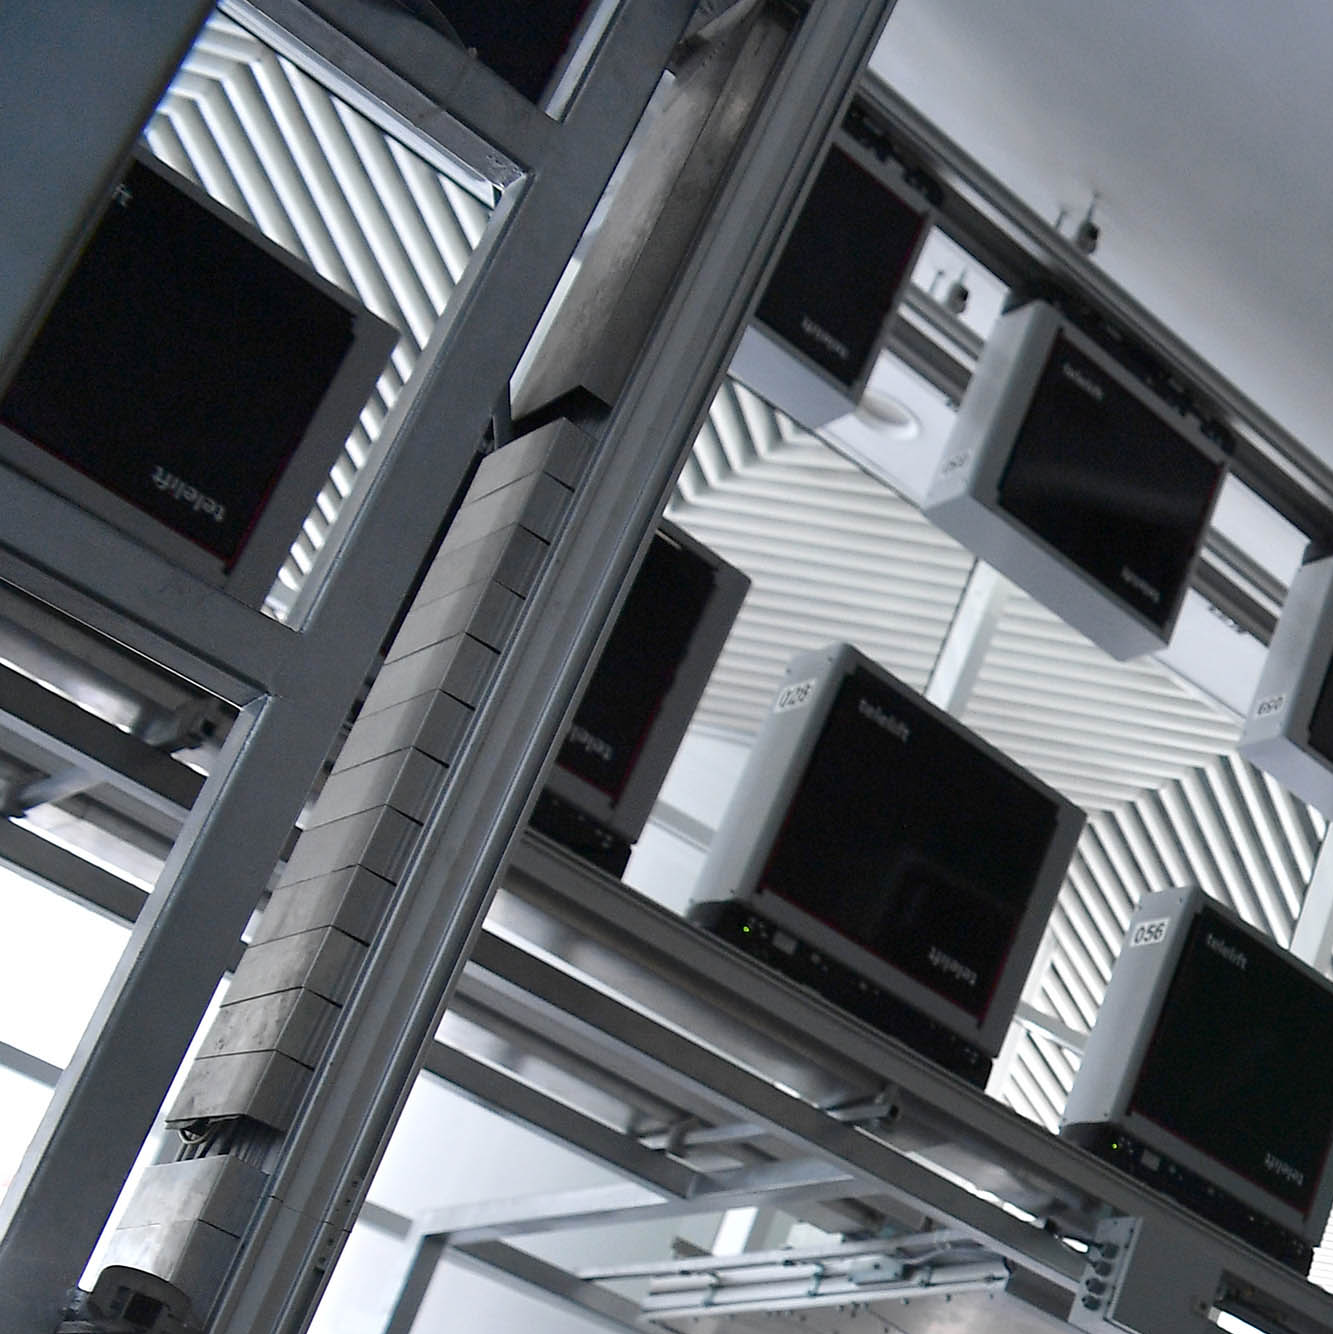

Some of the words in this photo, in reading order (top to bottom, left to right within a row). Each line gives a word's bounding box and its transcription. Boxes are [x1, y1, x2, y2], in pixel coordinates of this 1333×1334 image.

[150, 464, 225, 522] telelift
[1134, 921, 1167, 945] 056
[1206, 933, 1249, 972] telelift
[928, 944, 979, 987] telelift
[1264, 1151, 1305, 1187] telelift
